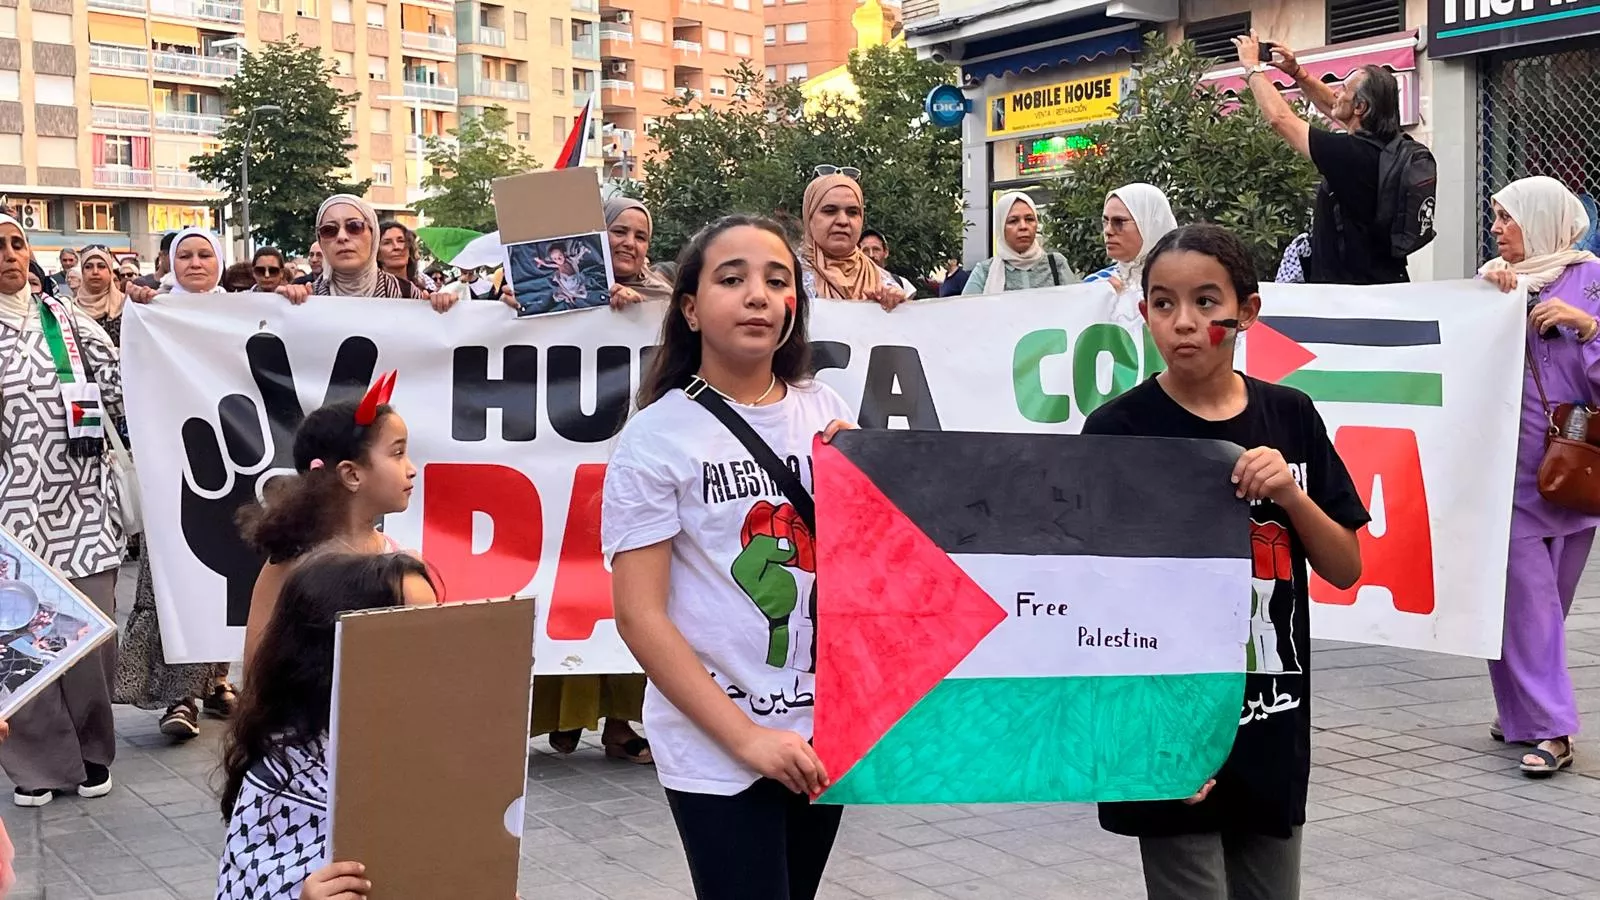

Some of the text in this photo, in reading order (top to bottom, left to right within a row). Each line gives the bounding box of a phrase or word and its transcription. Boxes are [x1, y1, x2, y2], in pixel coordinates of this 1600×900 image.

[932, 102, 964, 112] DIGI
[1012, 78, 1111, 112] MOBILE HOUSE
[1016, 591, 1068, 617] Free
[1077, 626, 1158, 650] Palestina
